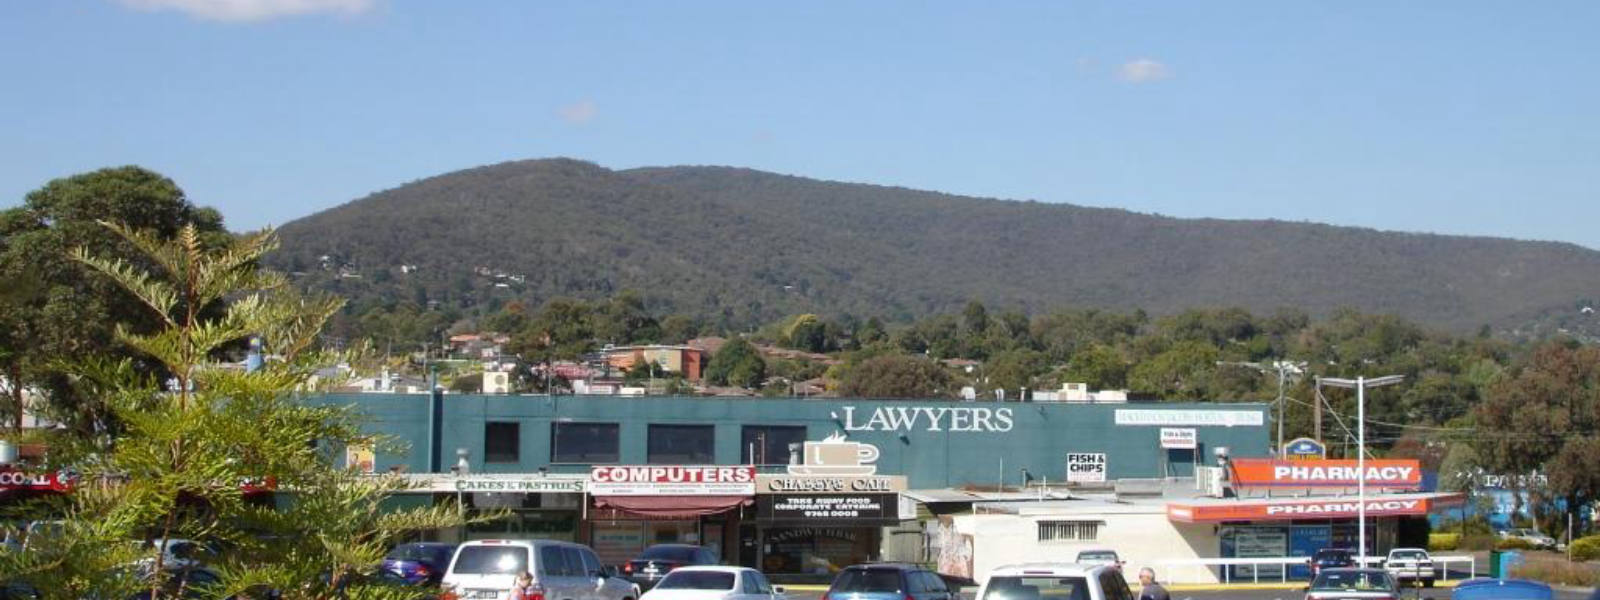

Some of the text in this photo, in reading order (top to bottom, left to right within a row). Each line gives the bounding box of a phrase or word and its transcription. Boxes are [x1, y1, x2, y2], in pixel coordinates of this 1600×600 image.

[843, 406, 1013, 432] LAWYERS
[1068, 454, 1104, 463] FISH &
[1070, 463, 1103, 473] CHIPS
[1275, 466, 1413, 481] PHARMACY
[456, 480, 505, 490] CAKES
[519, 480, 583, 491] PASTRIES
[774, 503, 831, 511] CORPORATE
[1266, 500, 1418, 515] PHARMACY
